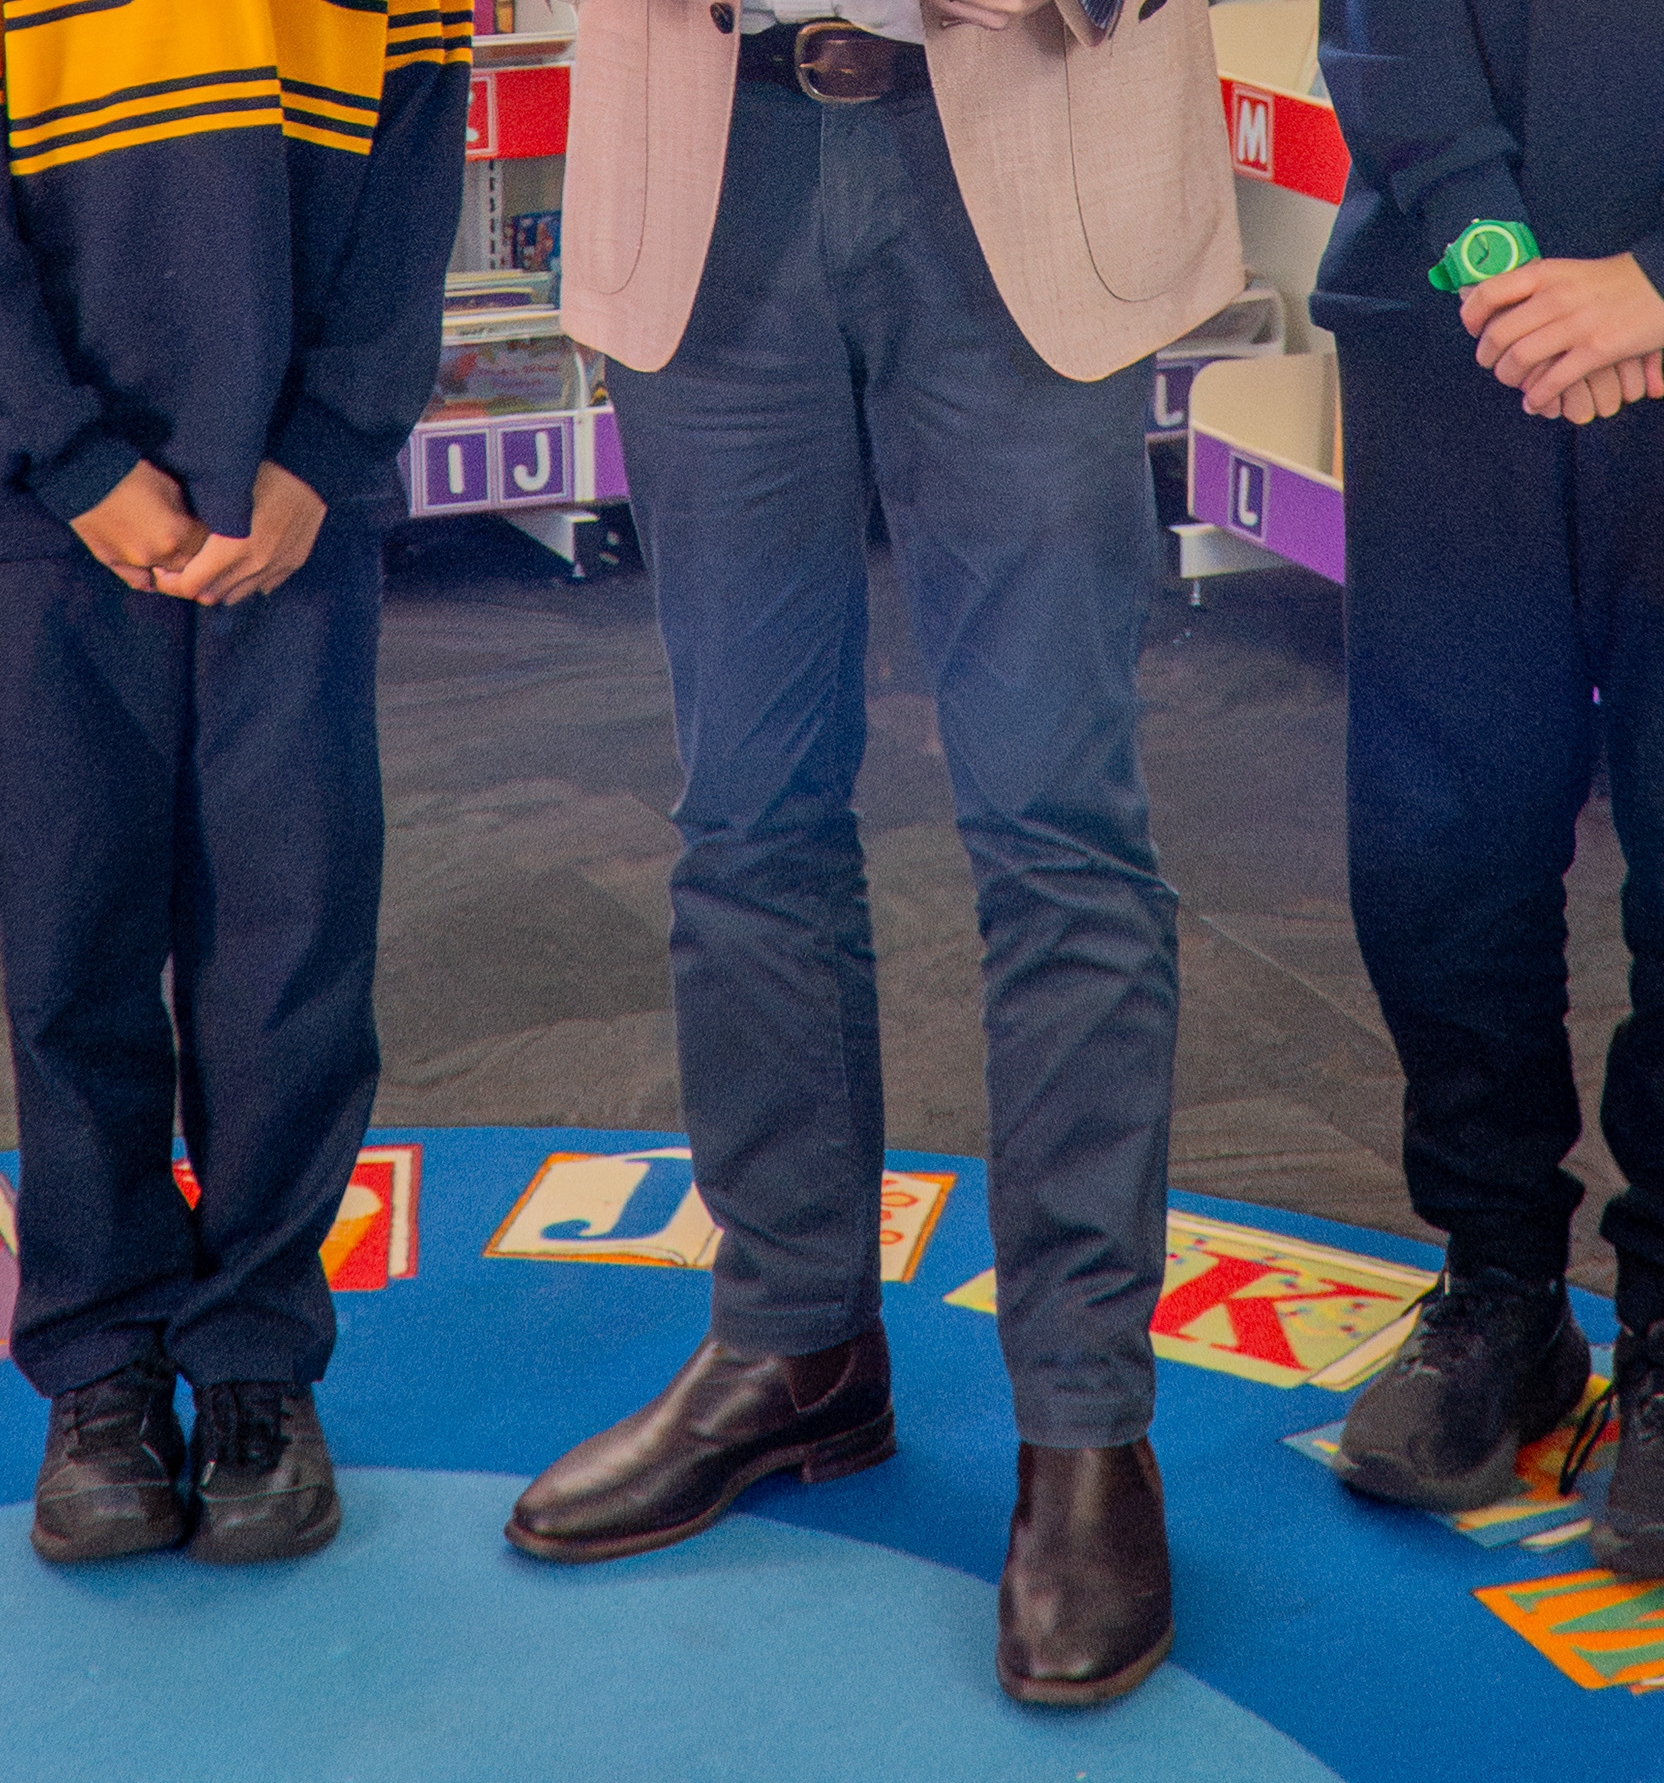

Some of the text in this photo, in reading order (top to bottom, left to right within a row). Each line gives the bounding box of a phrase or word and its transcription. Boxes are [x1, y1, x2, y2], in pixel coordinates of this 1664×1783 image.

[1237, 99, 1268, 165] M
[1155, 374, 1183, 428] L
[448, 430, 550, 495] I J
[1238, 464, 1259, 527] L
[540, 1157, 693, 1243] J
[1150, 1249, 1407, 1374] K
